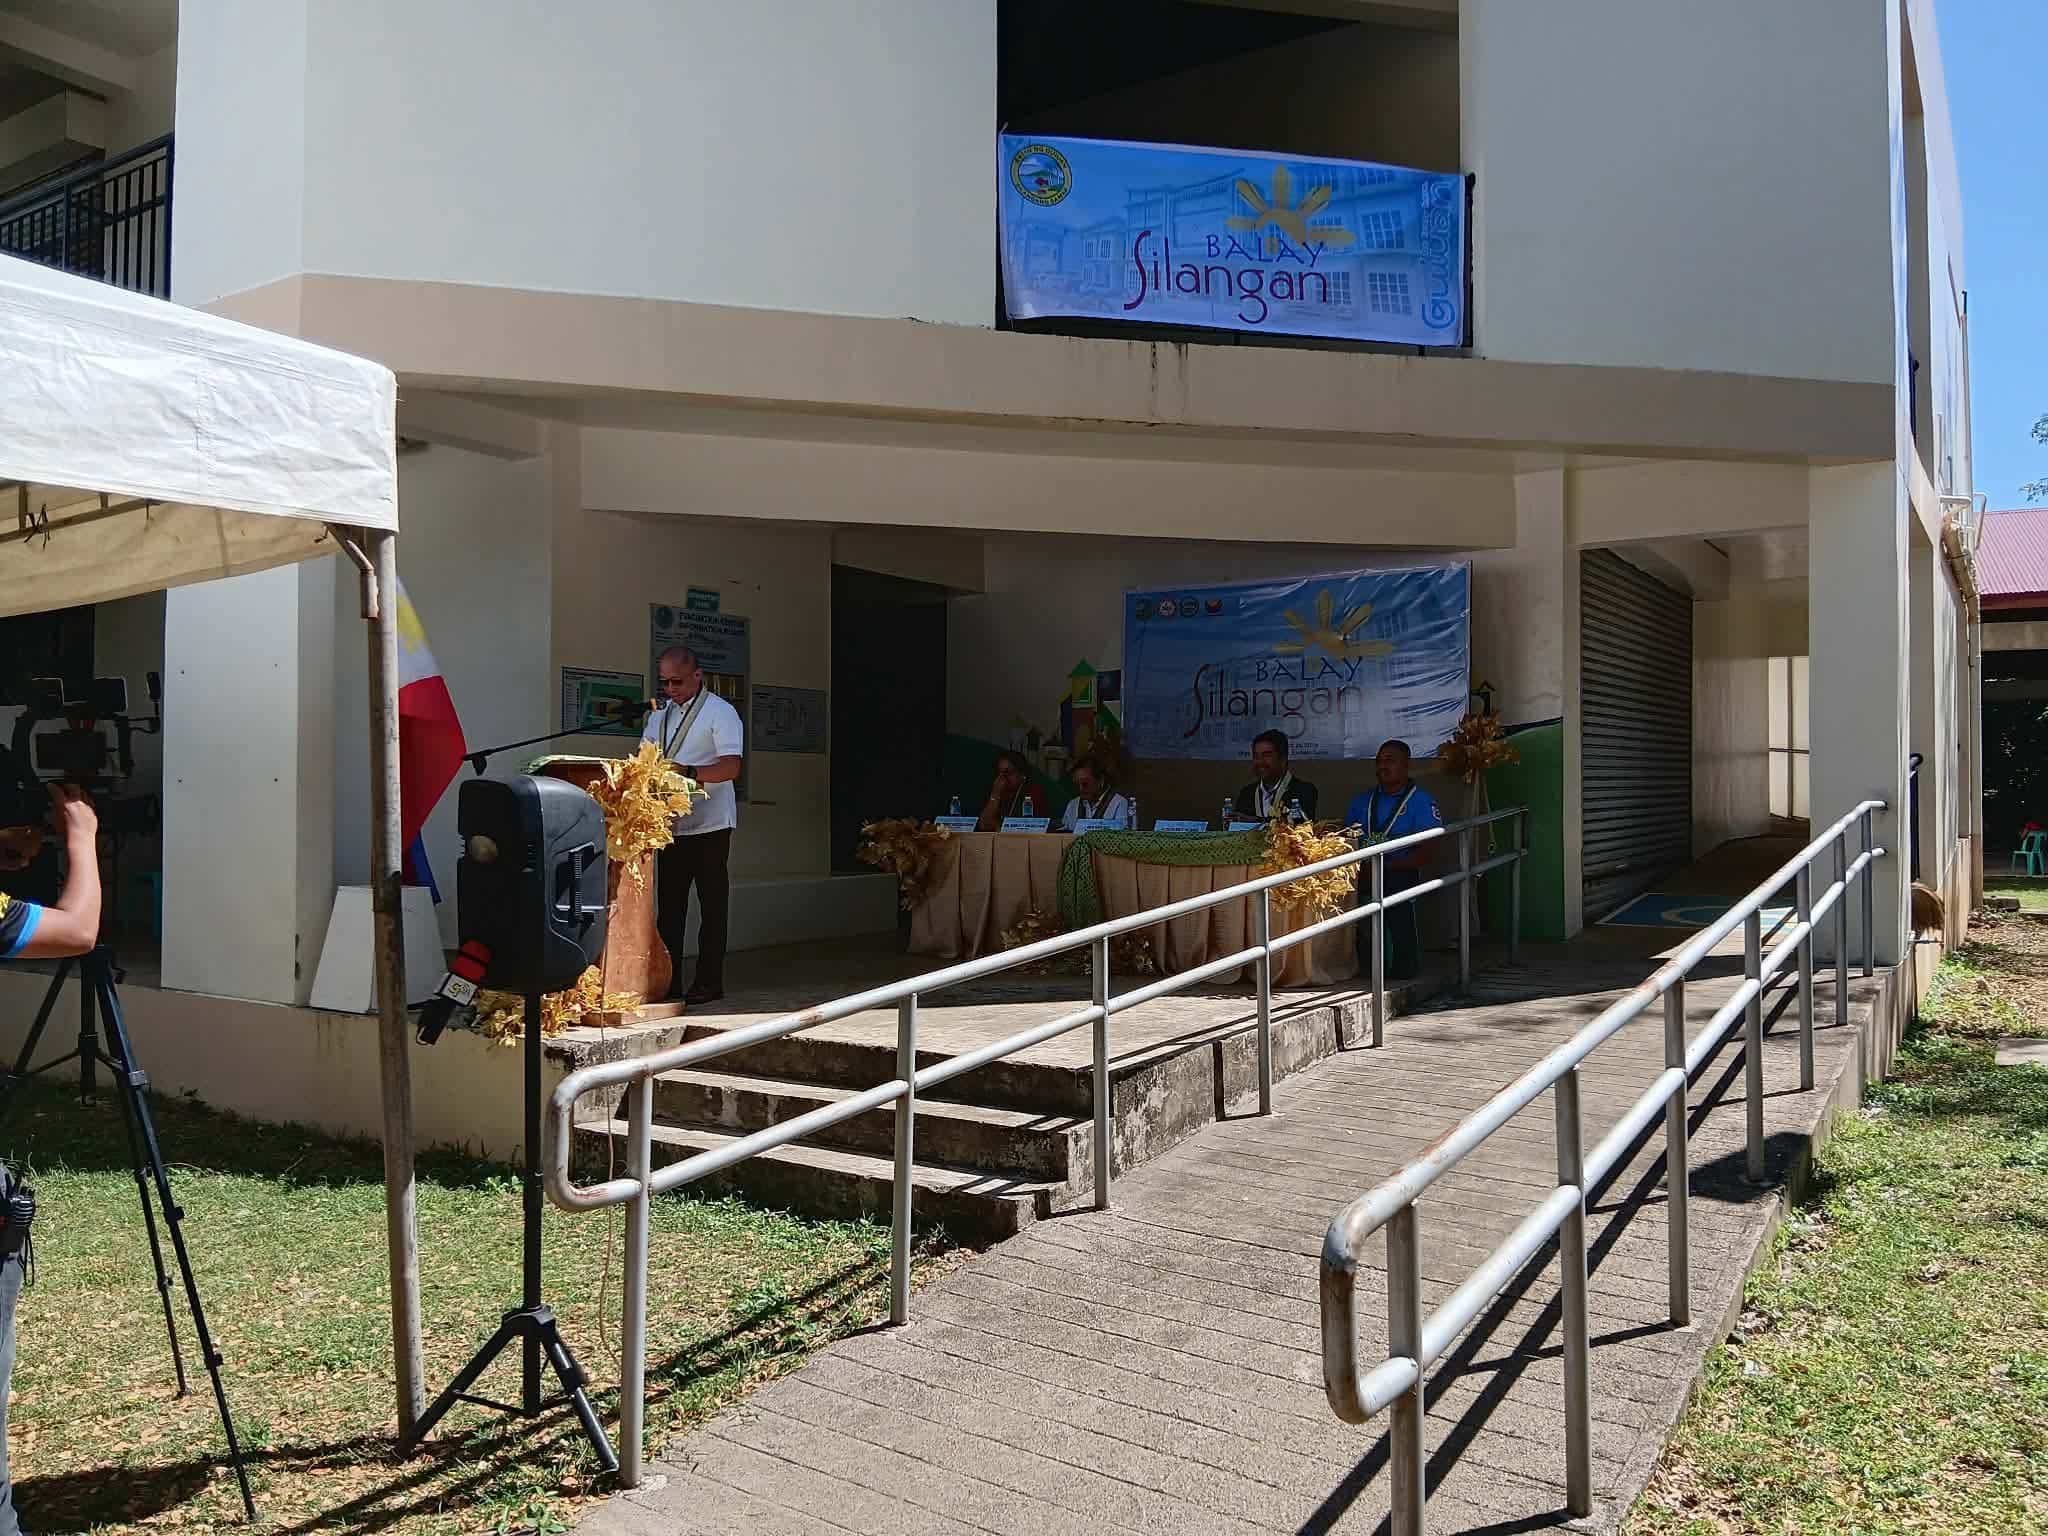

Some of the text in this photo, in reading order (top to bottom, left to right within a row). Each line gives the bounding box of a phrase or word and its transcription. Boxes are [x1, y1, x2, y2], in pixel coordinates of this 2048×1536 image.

[1123, 229, 1328, 325] Silangan
[1206, 233, 1325, 268] BALAY
[1255, 655, 1363, 682] BALAY
[1184, 663, 1362, 740] Silangan
